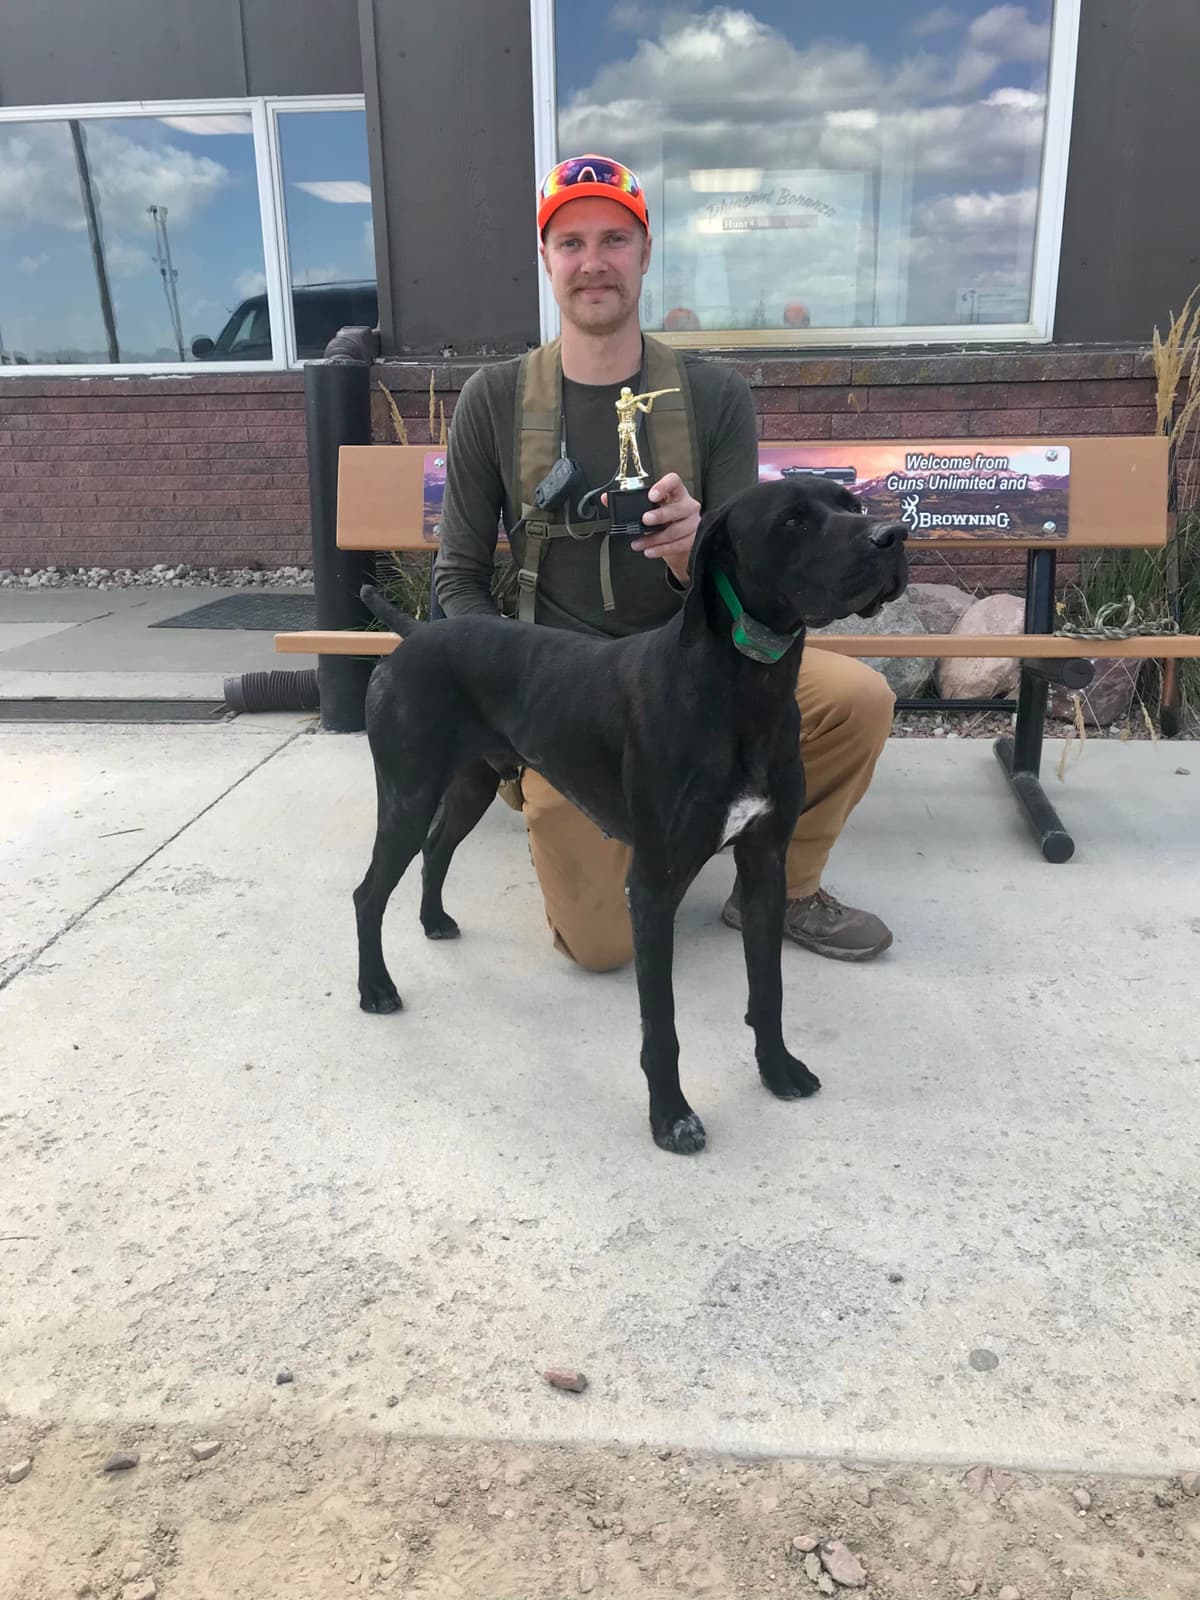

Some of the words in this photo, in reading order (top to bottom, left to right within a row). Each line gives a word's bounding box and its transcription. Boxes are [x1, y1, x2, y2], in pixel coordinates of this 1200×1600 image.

[776, 188, 836, 218] Bonanza
[906, 455, 971, 469] Welcome
[974, 454, 1008, 469] from
[887, 476, 924, 490] Guns
[928, 476, 996, 490] Unlimited
[999, 476, 1027, 490] and
[919, 512, 1010, 528] BROWNING
